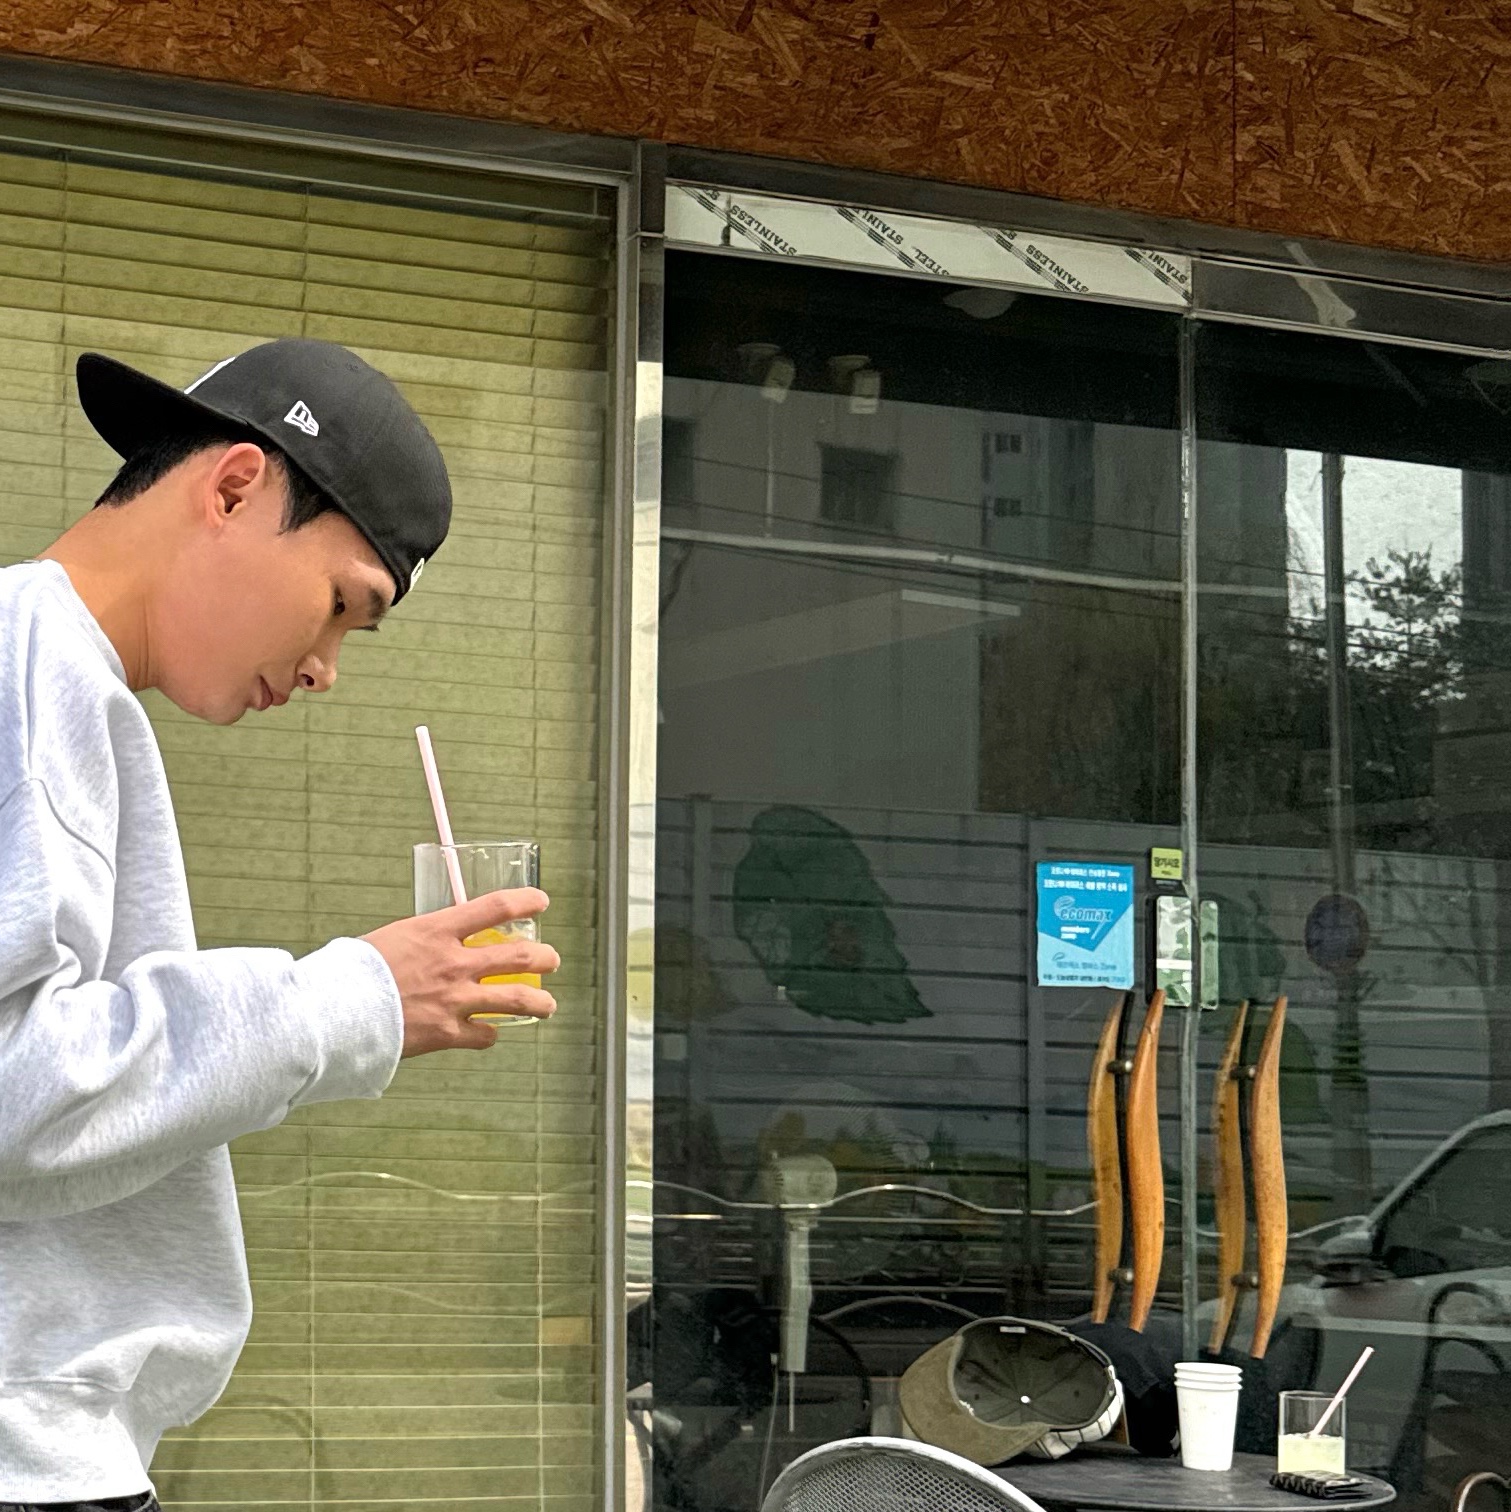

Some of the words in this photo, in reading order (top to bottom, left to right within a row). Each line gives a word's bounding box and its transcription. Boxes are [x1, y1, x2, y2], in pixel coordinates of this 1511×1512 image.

[730, 205, 797, 256] STAINLESS
[1026, 244, 1089, 293] STAINLESS
[1060, 908, 1112, 921] ecomax
